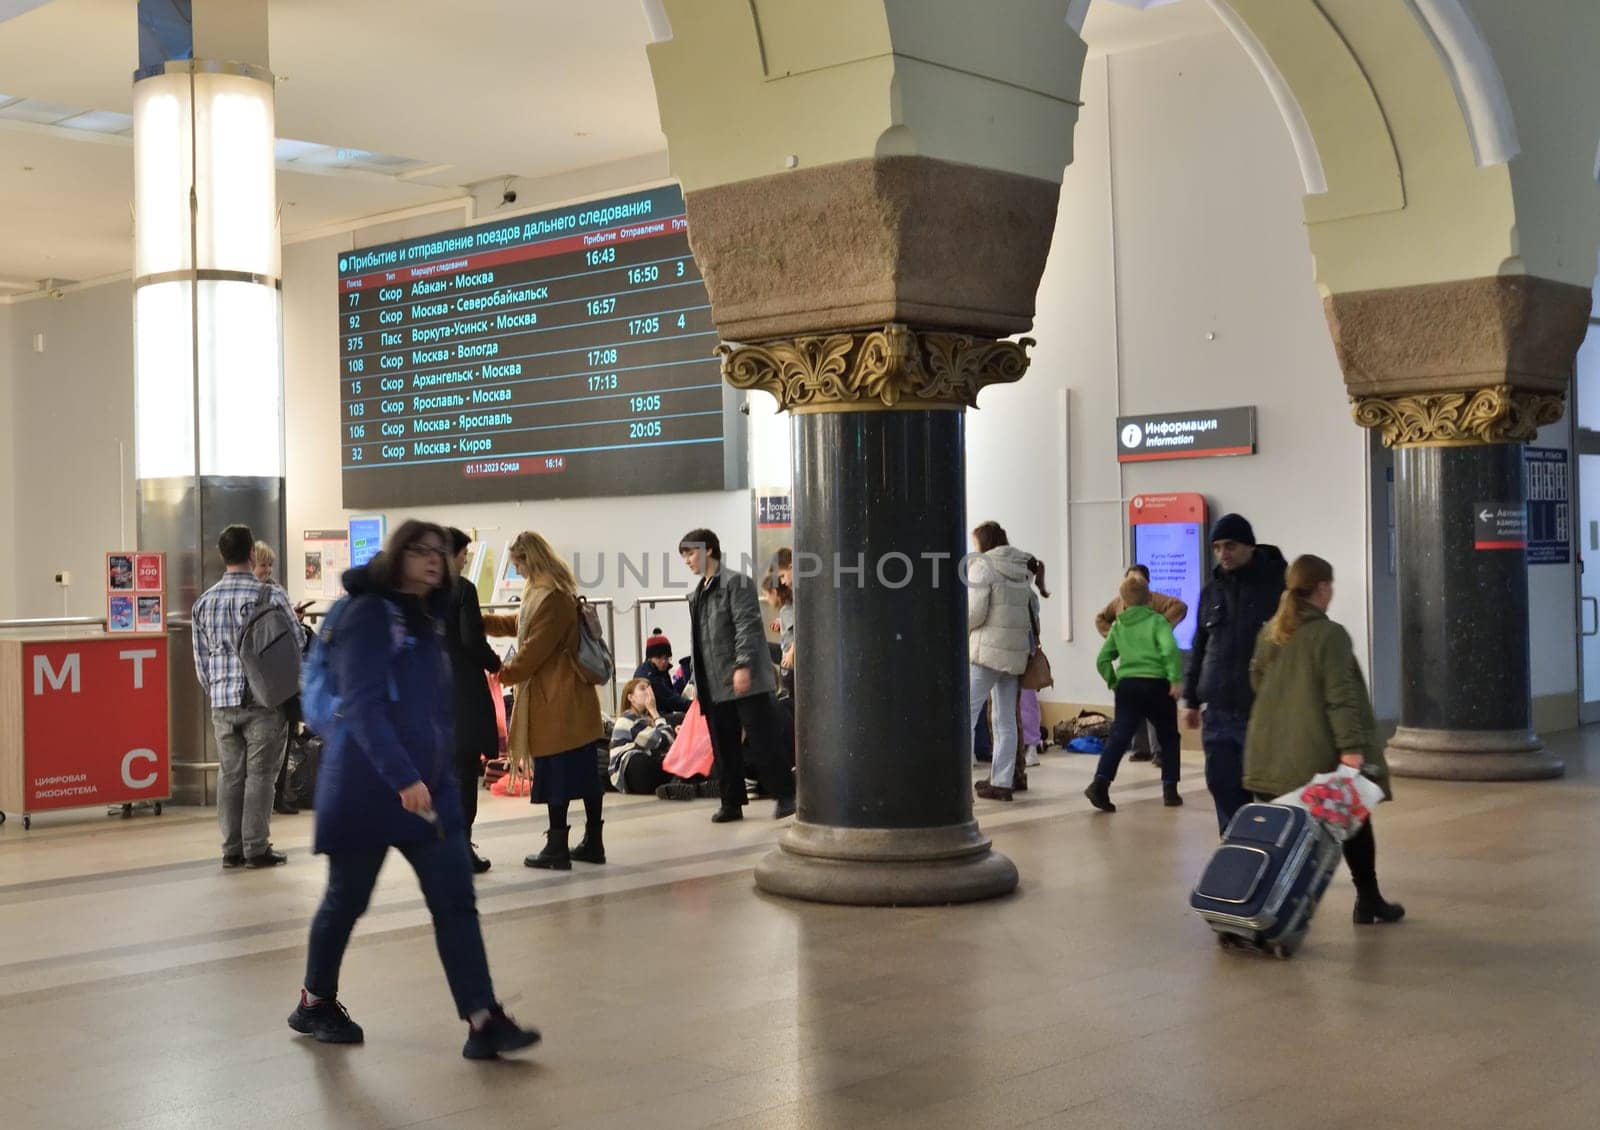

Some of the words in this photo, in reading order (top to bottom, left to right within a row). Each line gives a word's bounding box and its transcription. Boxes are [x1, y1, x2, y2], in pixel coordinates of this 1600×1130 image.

[349, 249, 397, 272] Прибытие
[400, 249, 406, 261] и
[408, 235, 474, 259] отправление
[476, 225, 521, 245] поездов
[523, 214, 576, 241] дальнего
[579, 199, 652, 226] следования
[583, 232, 617, 245] Прибытие
[620, 223, 665, 239] Отправление
[349, 293, 360, 307] 77
[379, 288, 403, 302] Скор
[411, 279, 447, 297] Абакан
[455, 271, 494, 289] Москва
[586, 248, 615, 266] 16:43
[349, 315, 360, 329] 92
[379, 310, 403, 325] Скор
[411, 302, 448, 319] Москва
[456, 286, 549, 312] Северобайкальск
[628, 266, 658, 284] 16:50
[676, 261, 685, 277] 3
[347, 337, 363, 351] 375
[381, 333, 402, 346] Пасс
[412, 319, 488, 343] Воркута-Усинск
[496, 312, 537, 329] Москва
[587, 298, 616, 316] 16:57
[348, 359, 364, 373] 108
[380, 354, 404, 369] Скор
[412, 348, 449, 365] Москва
[458, 341, 499, 358] Вологда
[628, 317, 659, 336] 17:05
[677, 313, 686, 329] 4
[351, 382, 362, 394] 15
[381, 377, 404, 392] Скор
[413, 370, 474, 388] Архангельск
[482, 362, 522, 379] Москва
[587, 349, 617, 366] 17:08
[349, 403, 364, 416] 103
[381, 400, 404, 415] Скор
[413, 394, 464, 412] Ярославль
[472, 387, 512, 404] Москва
[587, 374, 618, 391] 17:13
[350, 426, 365, 439] 106
[381, 422, 405, 437] Скор
[413, 417, 450, 433] Москва
[459, 411, 513, 431] Ярославль
[630, 395, 661, 412] 19:05
[1145, 418, 1218, 436] Информация
[352, 448, 362, 461] 32
[382, 445, 405, 459] Скор
[414, 440, 450, 456] Москва
[459, 437, 492, 454] Киров
[630, 421, 661, 438] 20:05
[1146, 434, 1194, 447] Information
[466, 463, 499, 474] 01.11.2023
[499, 462, 520, 473] Среда
[545, 458, 563, 468] 16:14
[35, 774, 87, 787] ЦИФРОВАЯ
[35, 785, 98, 799] ЭКОСИСТЕМА
